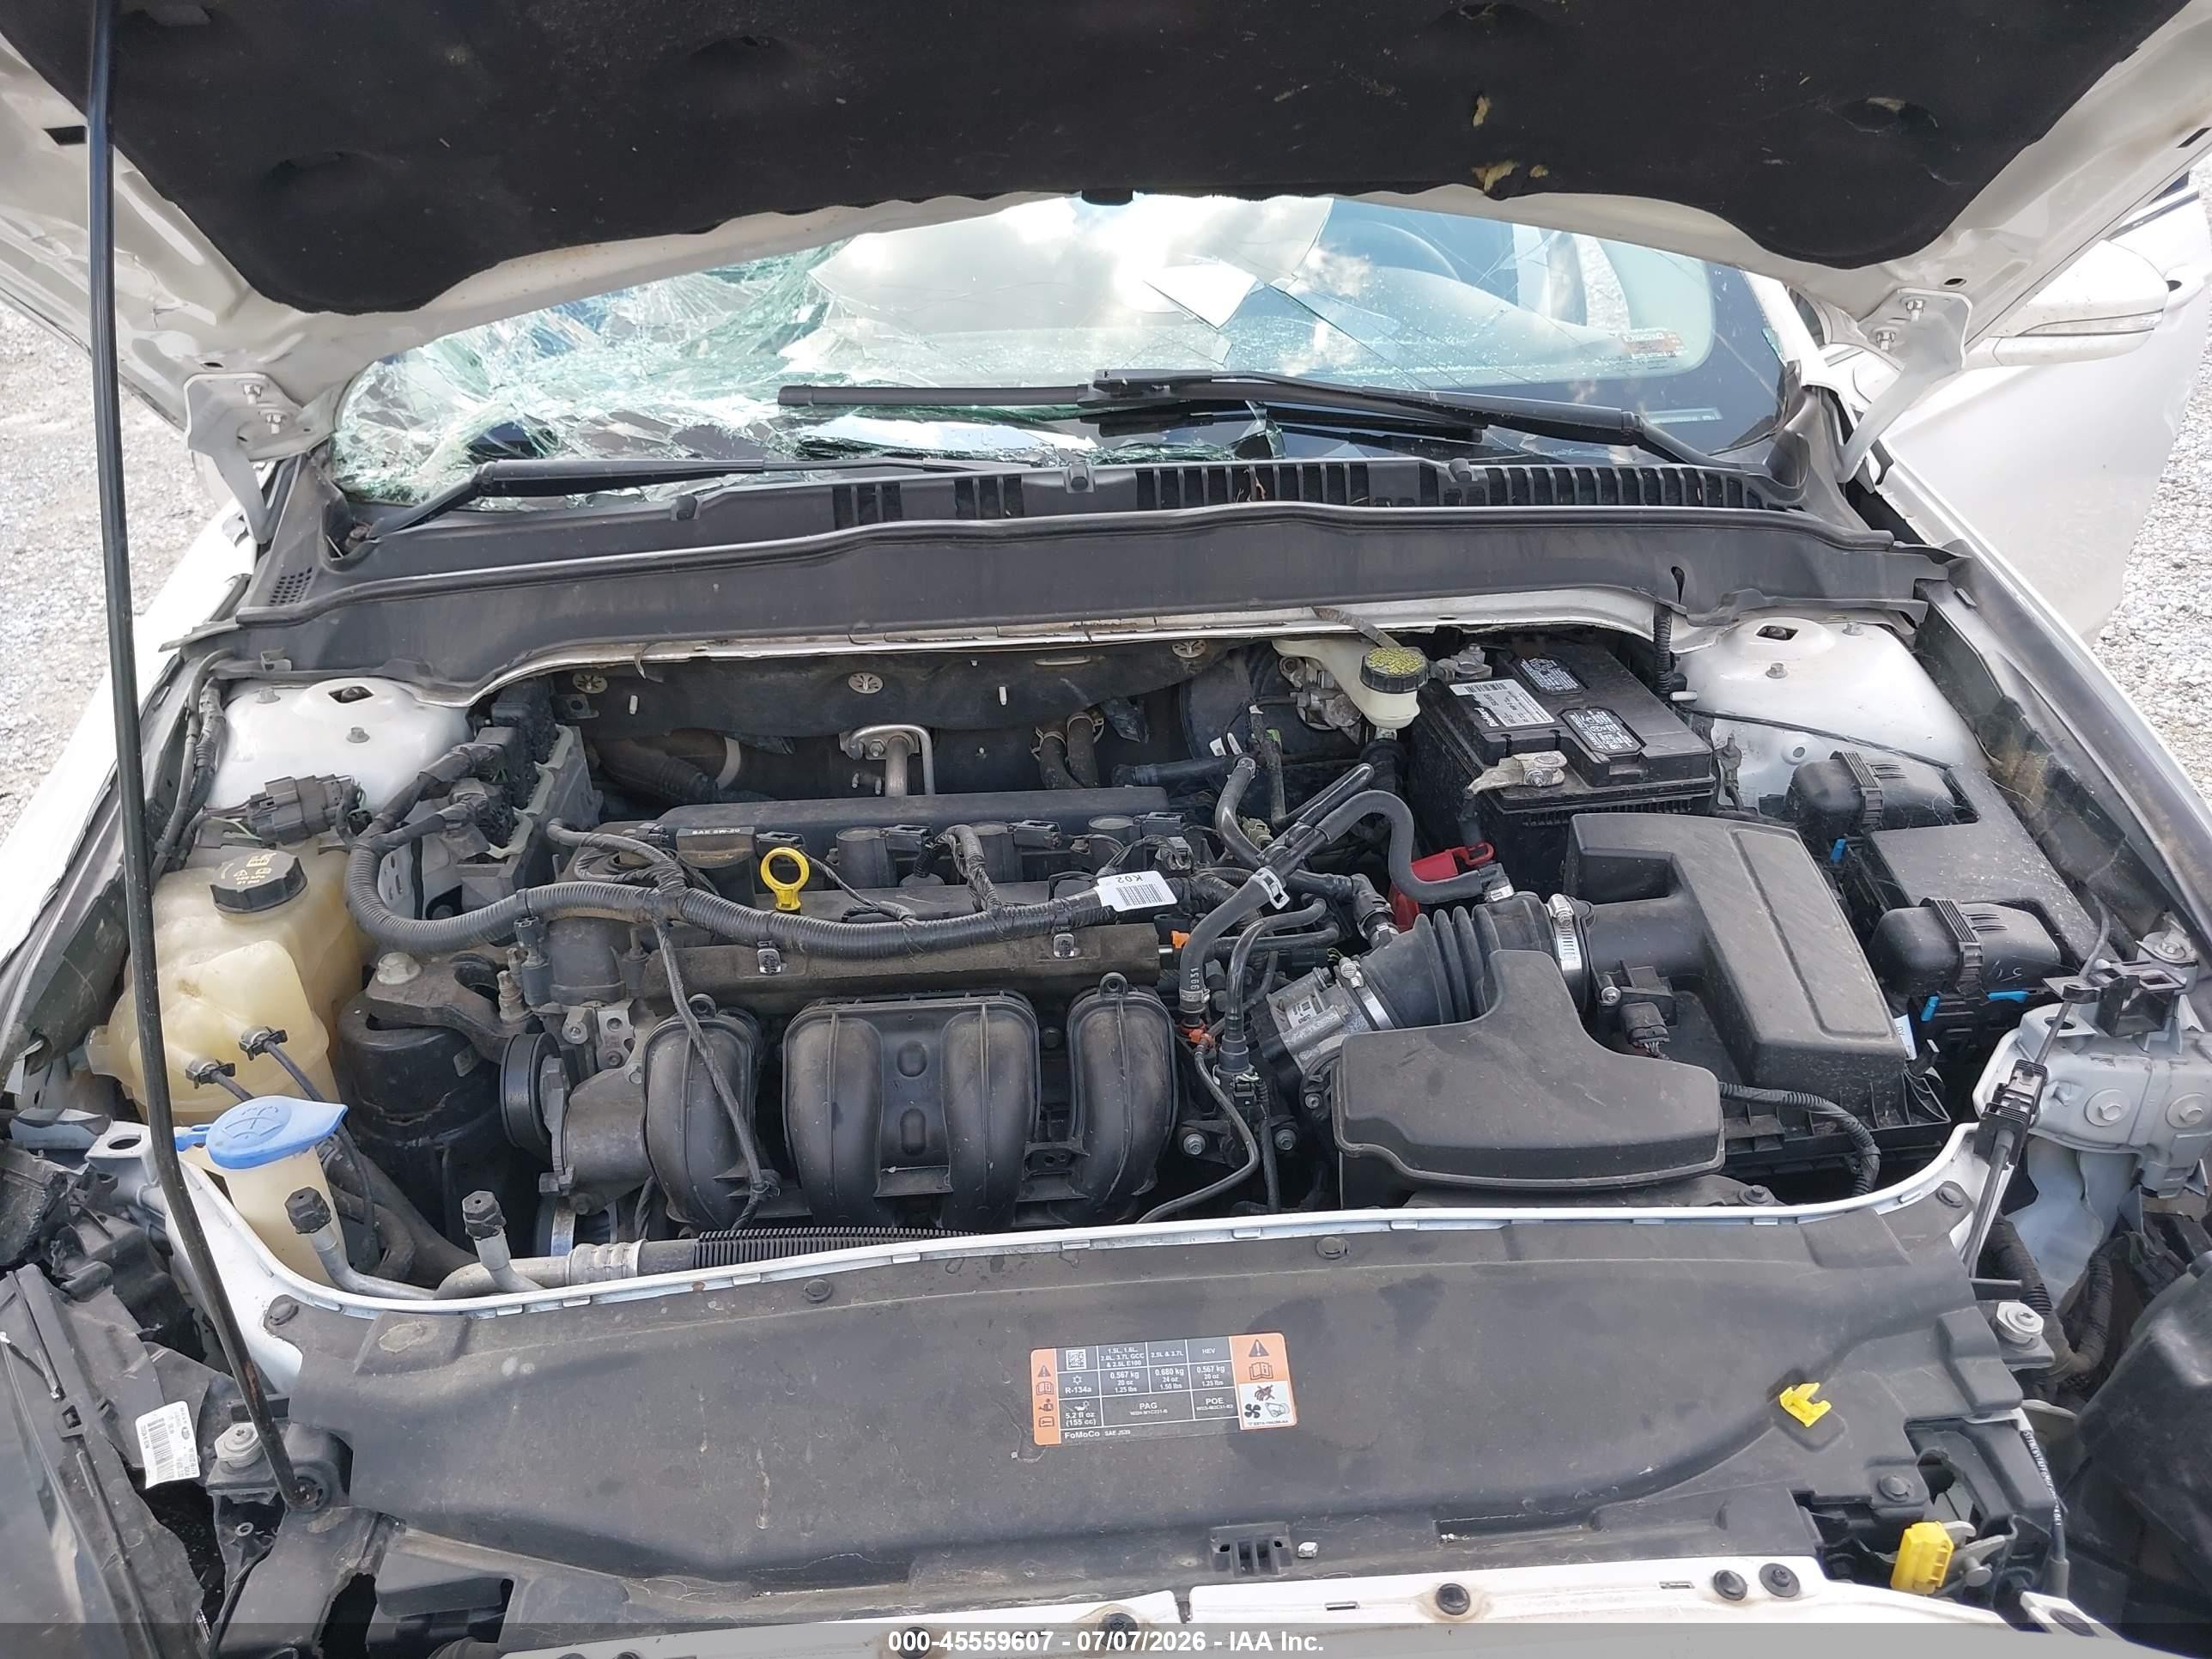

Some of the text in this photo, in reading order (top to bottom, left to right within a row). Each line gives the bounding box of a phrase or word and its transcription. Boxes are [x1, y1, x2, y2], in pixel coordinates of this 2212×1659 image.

[1175, 1367, 1184, 1376] kg
[1196, 1364, 1225, 1374] 0.567 kg
[1130, 1370, 1140, 1379] kg
[1064, 1431, 1100, 1439] FoMoCo
